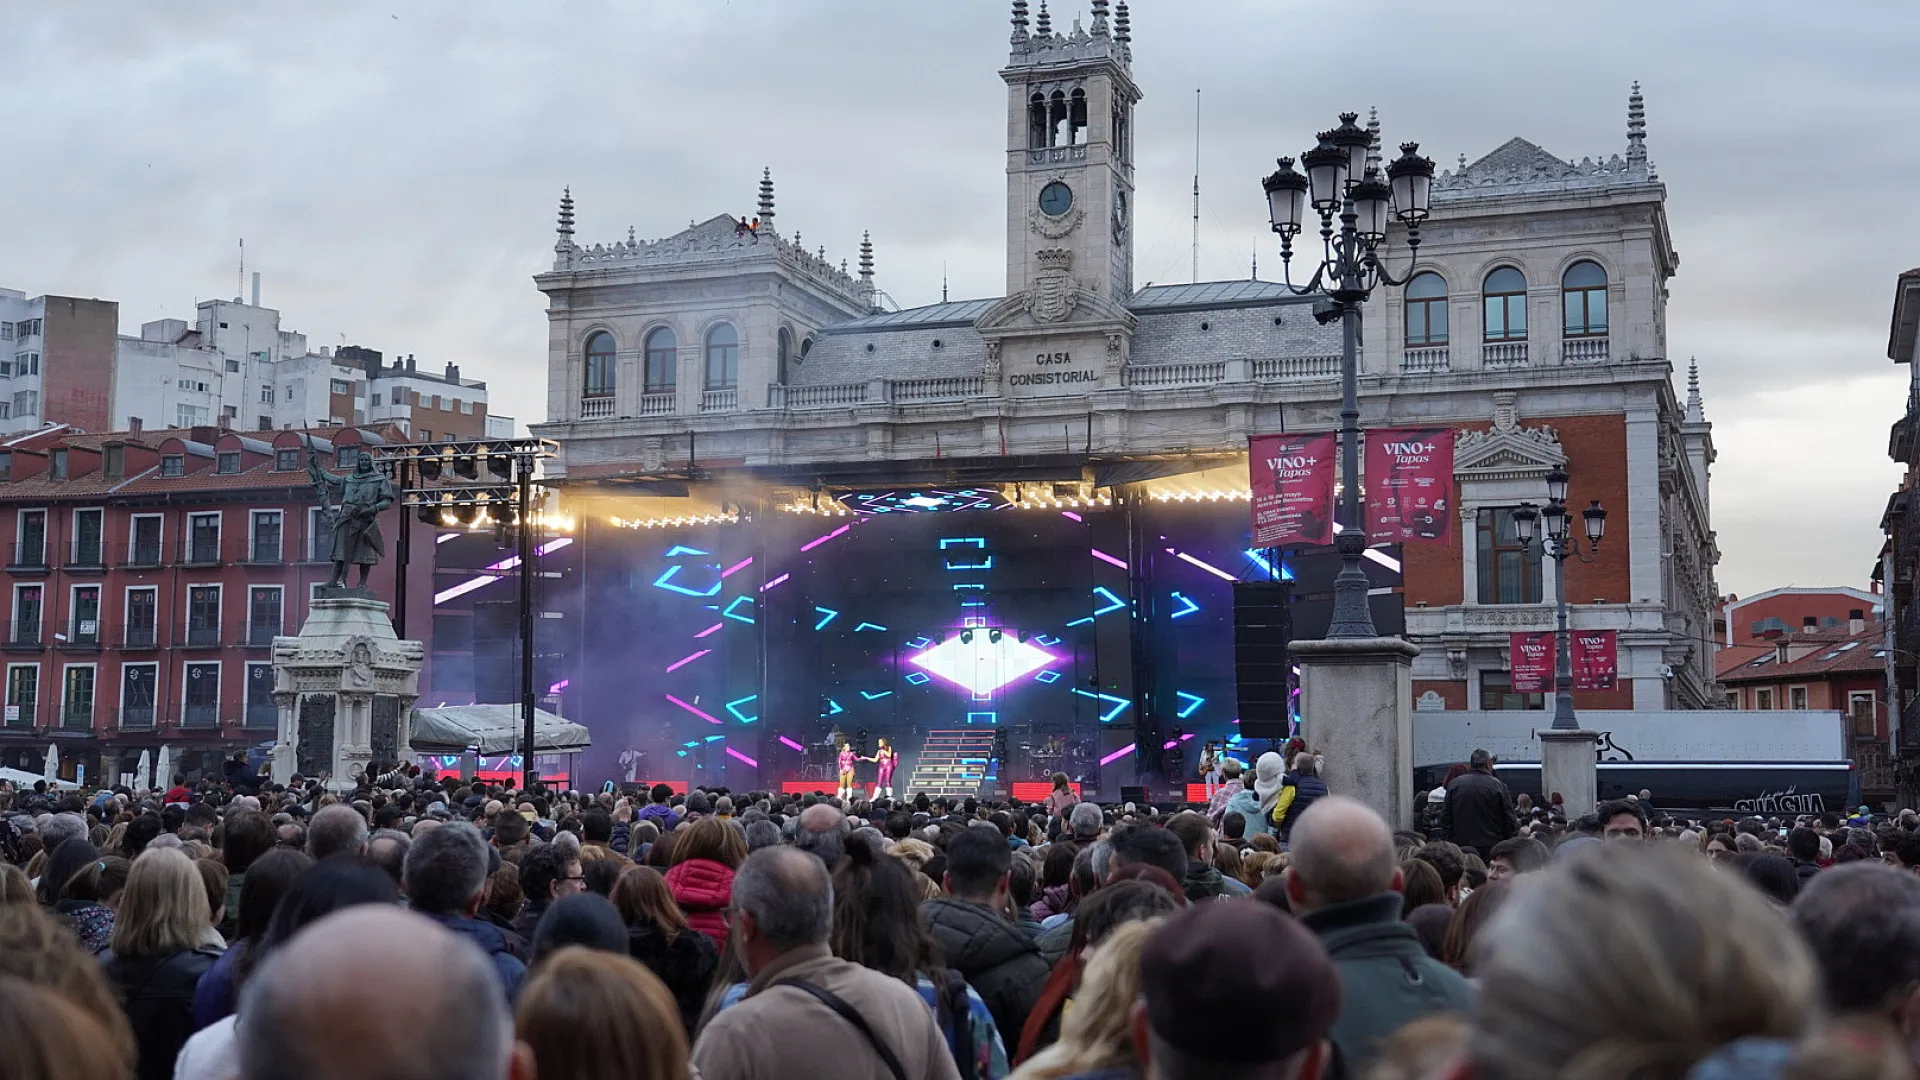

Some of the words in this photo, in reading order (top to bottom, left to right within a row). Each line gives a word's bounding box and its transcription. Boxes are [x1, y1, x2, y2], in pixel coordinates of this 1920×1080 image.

[1036, 352, 1072, 366] CASA
[1009, 370, 1100, 386] CONSISTORIAL
[1395, 455, 1430, 464] Tapas
[1279, 469, 1312, 478] Tapas
